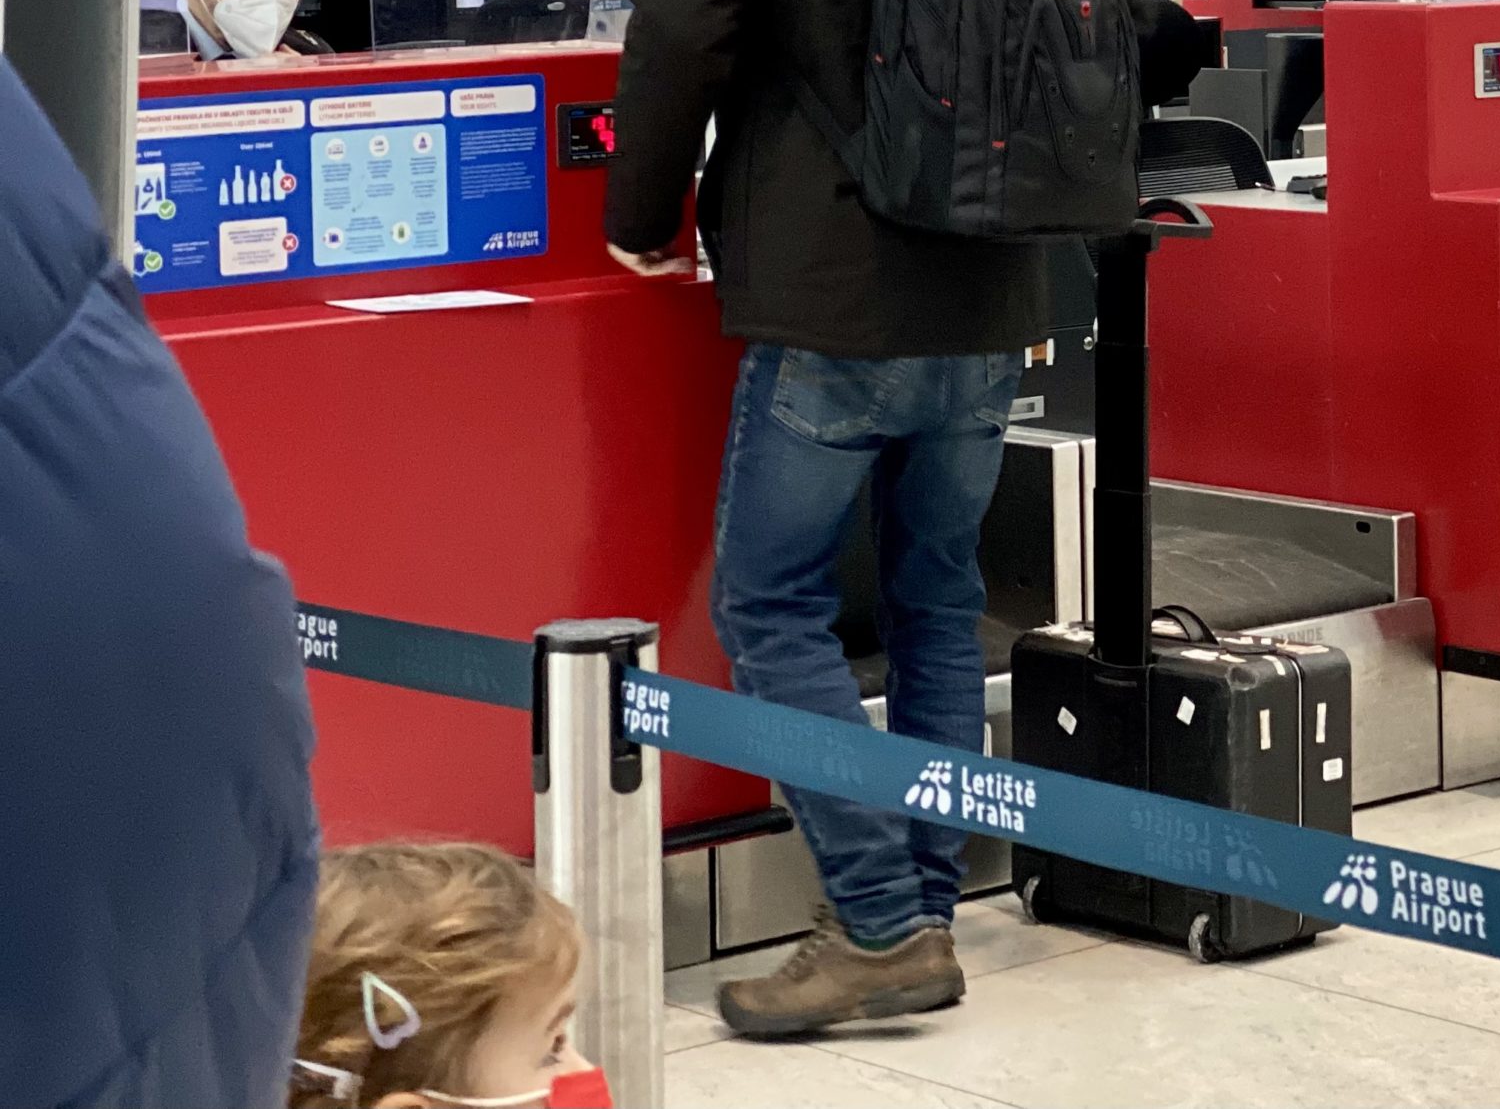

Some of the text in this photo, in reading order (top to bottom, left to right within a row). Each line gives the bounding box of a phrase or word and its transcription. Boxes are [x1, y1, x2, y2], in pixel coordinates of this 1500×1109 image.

[296, 611, 338, 637] ague
[625, 681, 671, 712] ague
[960, 762, 1037, 810] Letiště
[960, 793, 1026, 834] Praha
[1390, 859, 1485, 907] Prague
[1391, 890, 1487, 940] Airport
